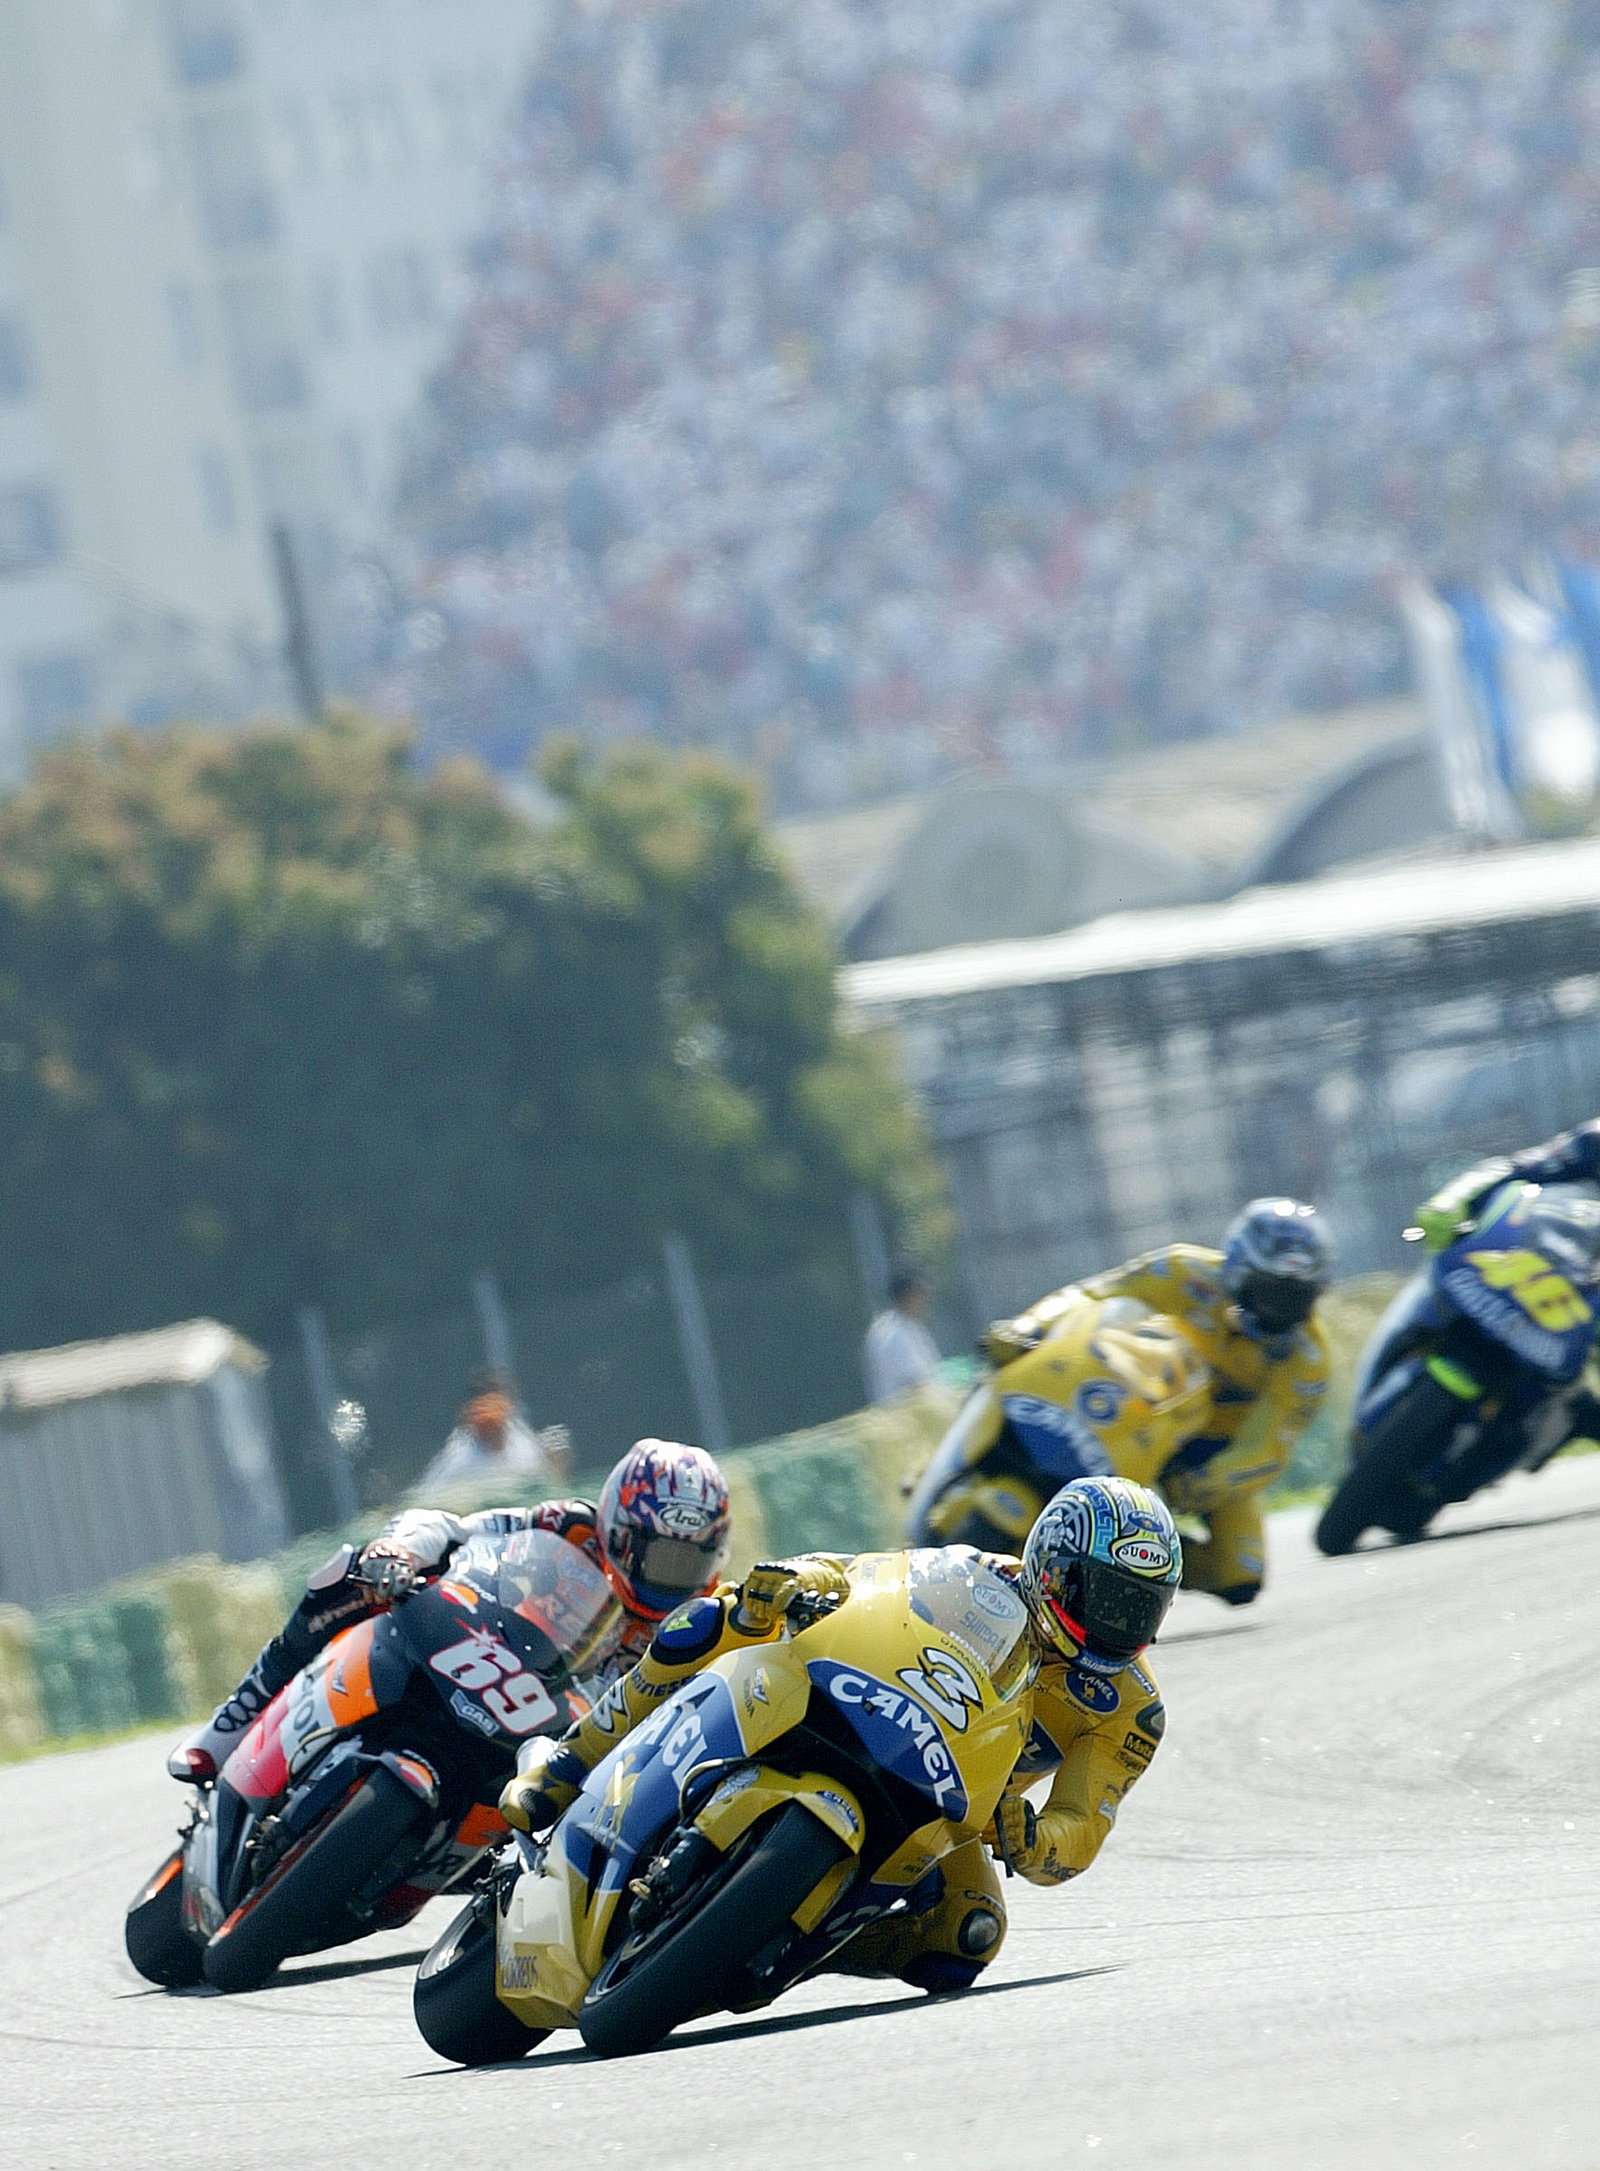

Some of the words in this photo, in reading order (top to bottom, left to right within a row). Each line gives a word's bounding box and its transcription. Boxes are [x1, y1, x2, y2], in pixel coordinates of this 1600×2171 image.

[1121, 1545, 1169, 1567] SUOMY
[429, 1637, 558, 1735] 69
[1078, 1672, 1115, 1701] CAMEL
[829, 1673, 957, 1808] CAMEL
